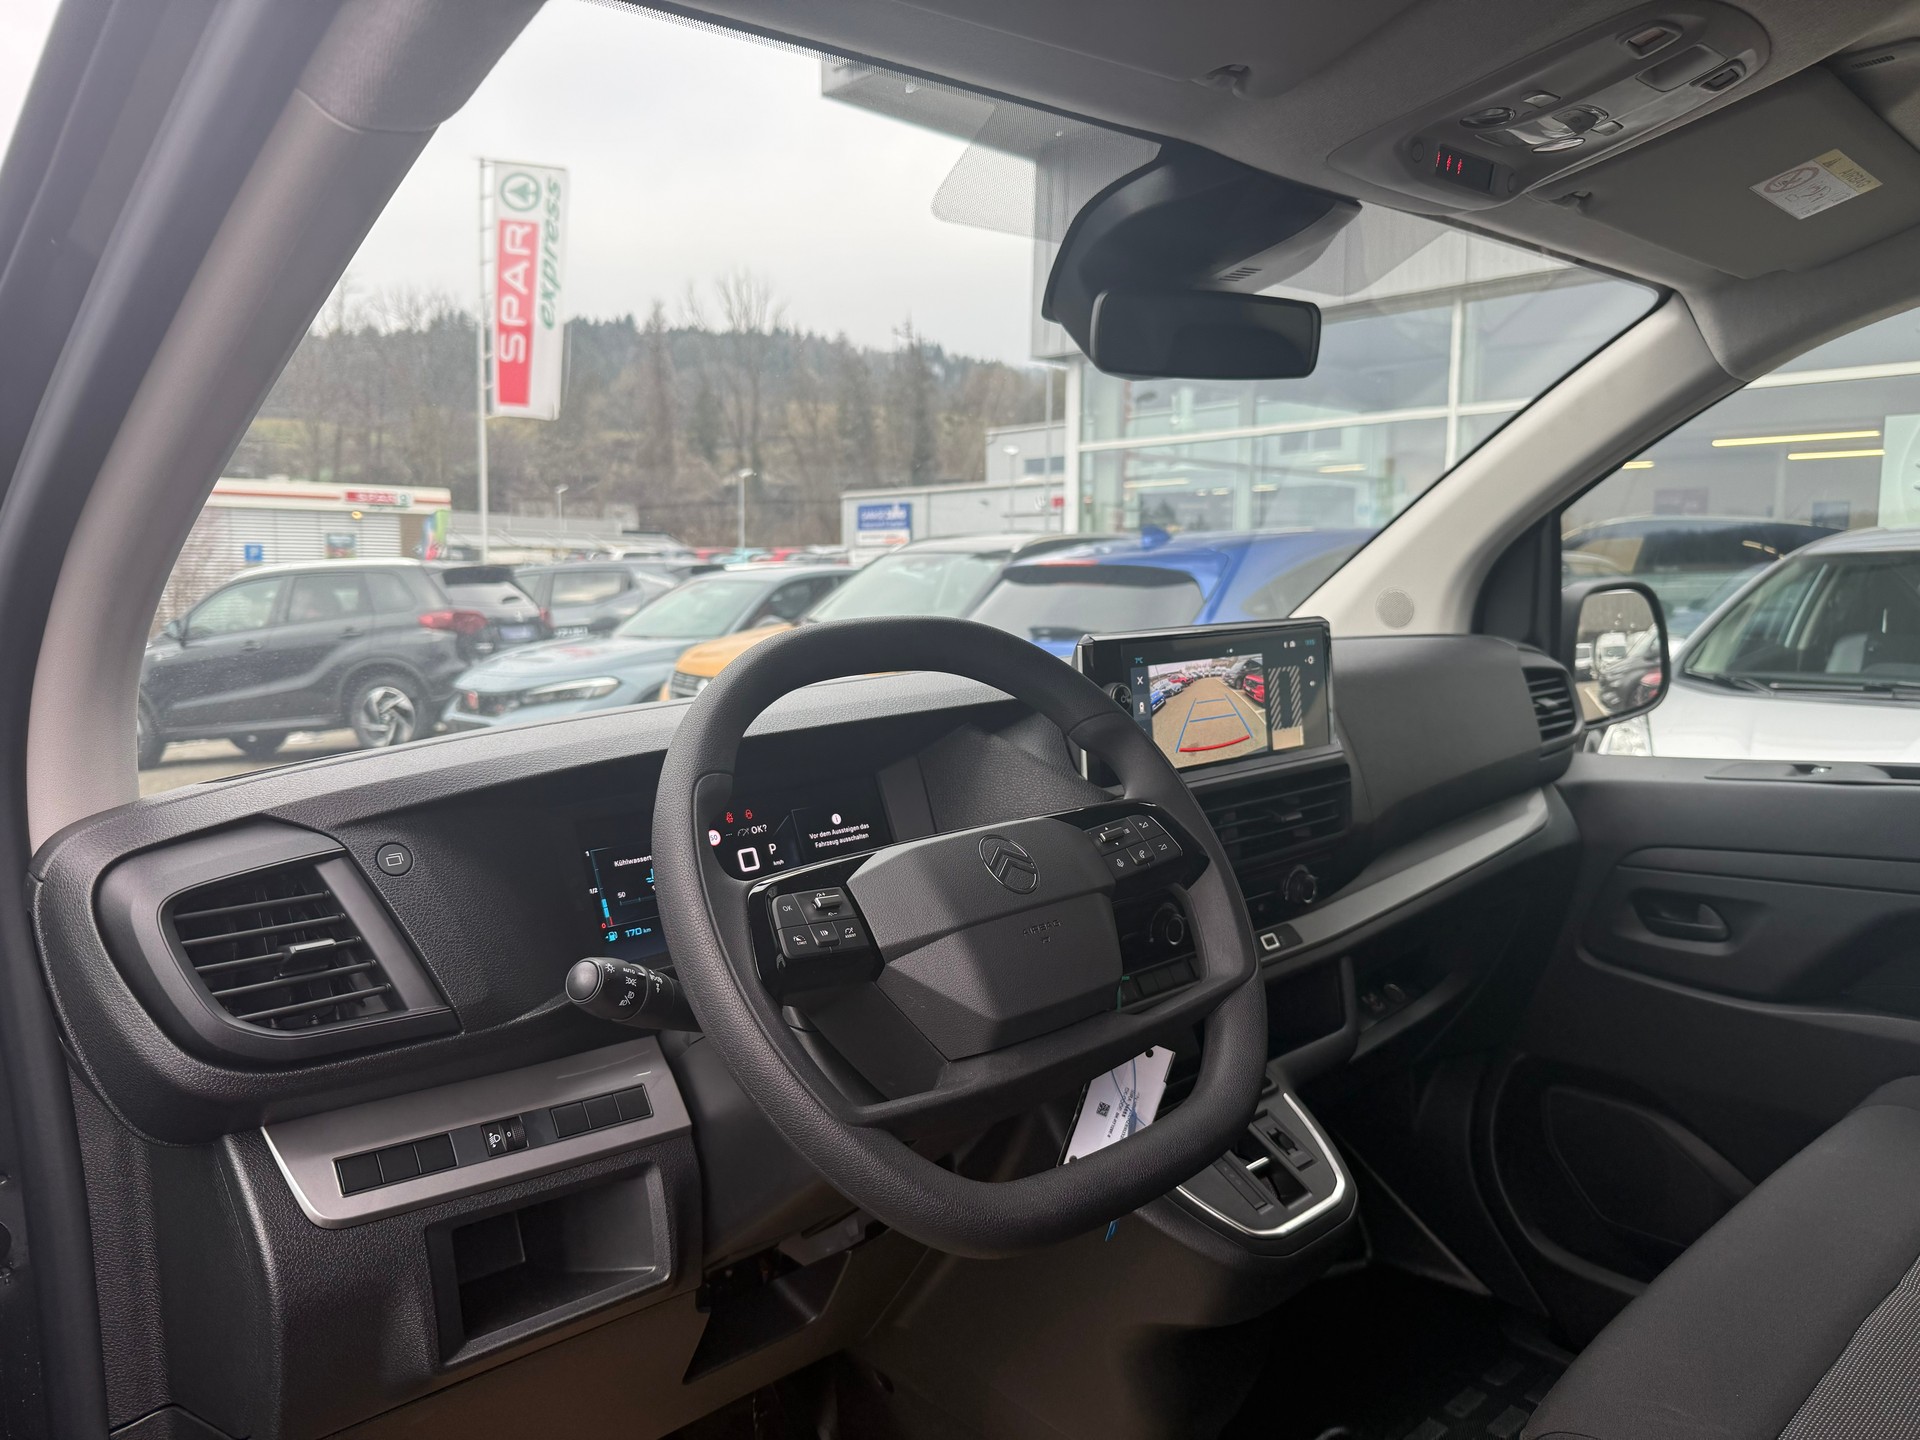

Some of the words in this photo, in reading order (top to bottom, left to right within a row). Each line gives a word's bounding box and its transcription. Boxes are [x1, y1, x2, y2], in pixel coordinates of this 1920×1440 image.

[538, 180, 562, 330] express
[501, 223, 532, 364] SPAR
[751, 824, 768, 834] OK?
[832, 825, 860, 835] Aussteigen
[814, 839, 840, 848] Fahrzeug
[839, 833, 870, 844] ausschalten
[768, 843, 777, 855] P
[617, 891, 626, 899] 50
[625, 927, 642, 937] 170
